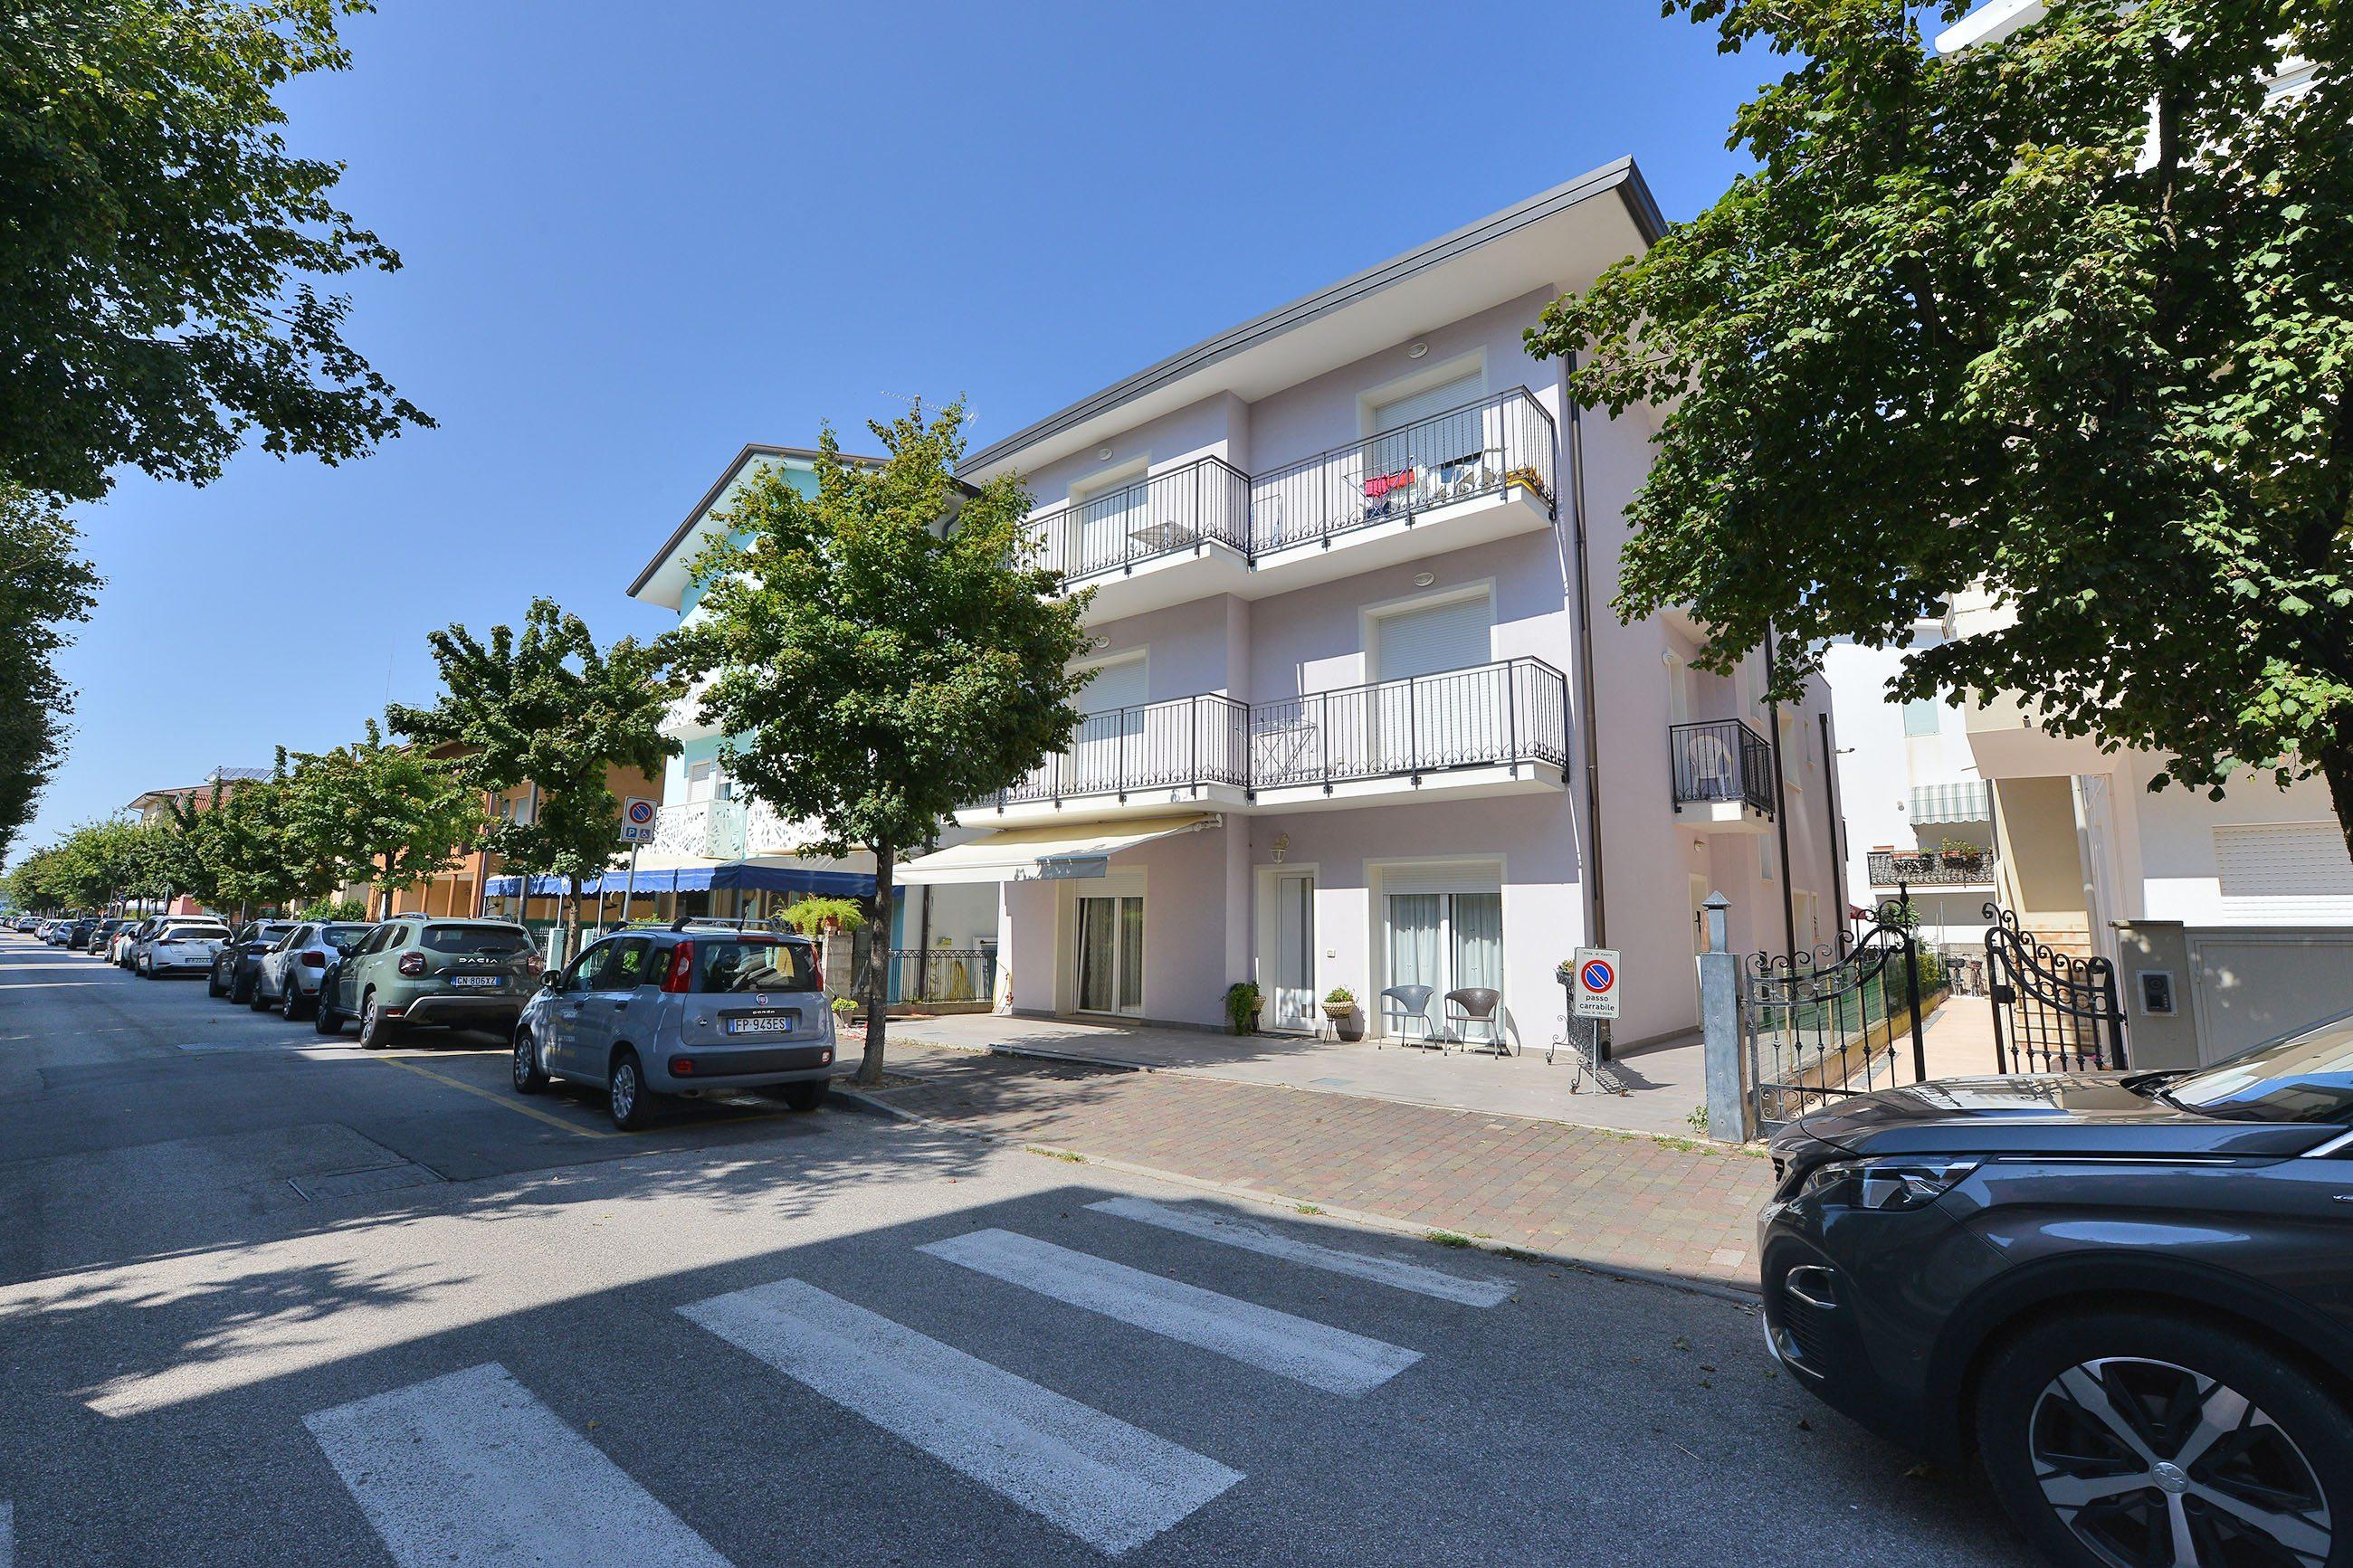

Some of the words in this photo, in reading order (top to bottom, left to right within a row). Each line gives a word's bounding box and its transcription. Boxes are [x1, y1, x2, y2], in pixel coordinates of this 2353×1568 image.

[1579, 1003, 1615, 1011] carrabile
[736, 1019, 749, 1031] FP
[753, 1018, 786, 1031] 943ES
